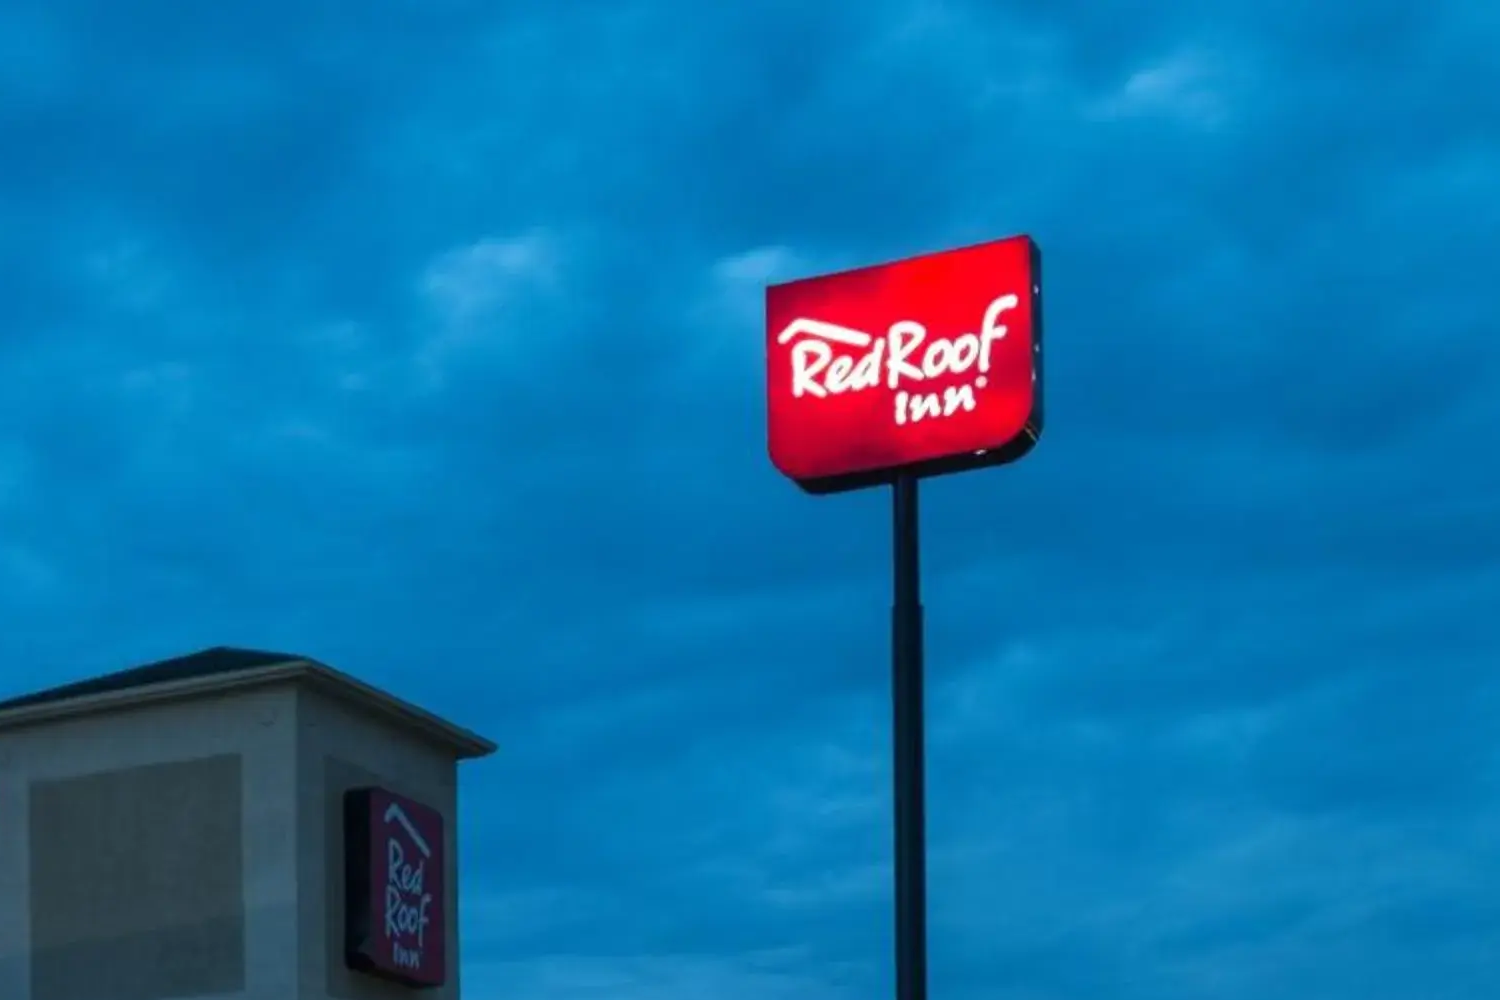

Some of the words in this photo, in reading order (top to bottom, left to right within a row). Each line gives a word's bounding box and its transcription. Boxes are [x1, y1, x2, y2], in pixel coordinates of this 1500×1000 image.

[791, 337, 885, 398] Red
[887, 293, 1019, 389] Roof
[894, 383, 976, 425] Inn
[387, 837, 425, 895] Red
[384, 883, 433, 948] Roof
